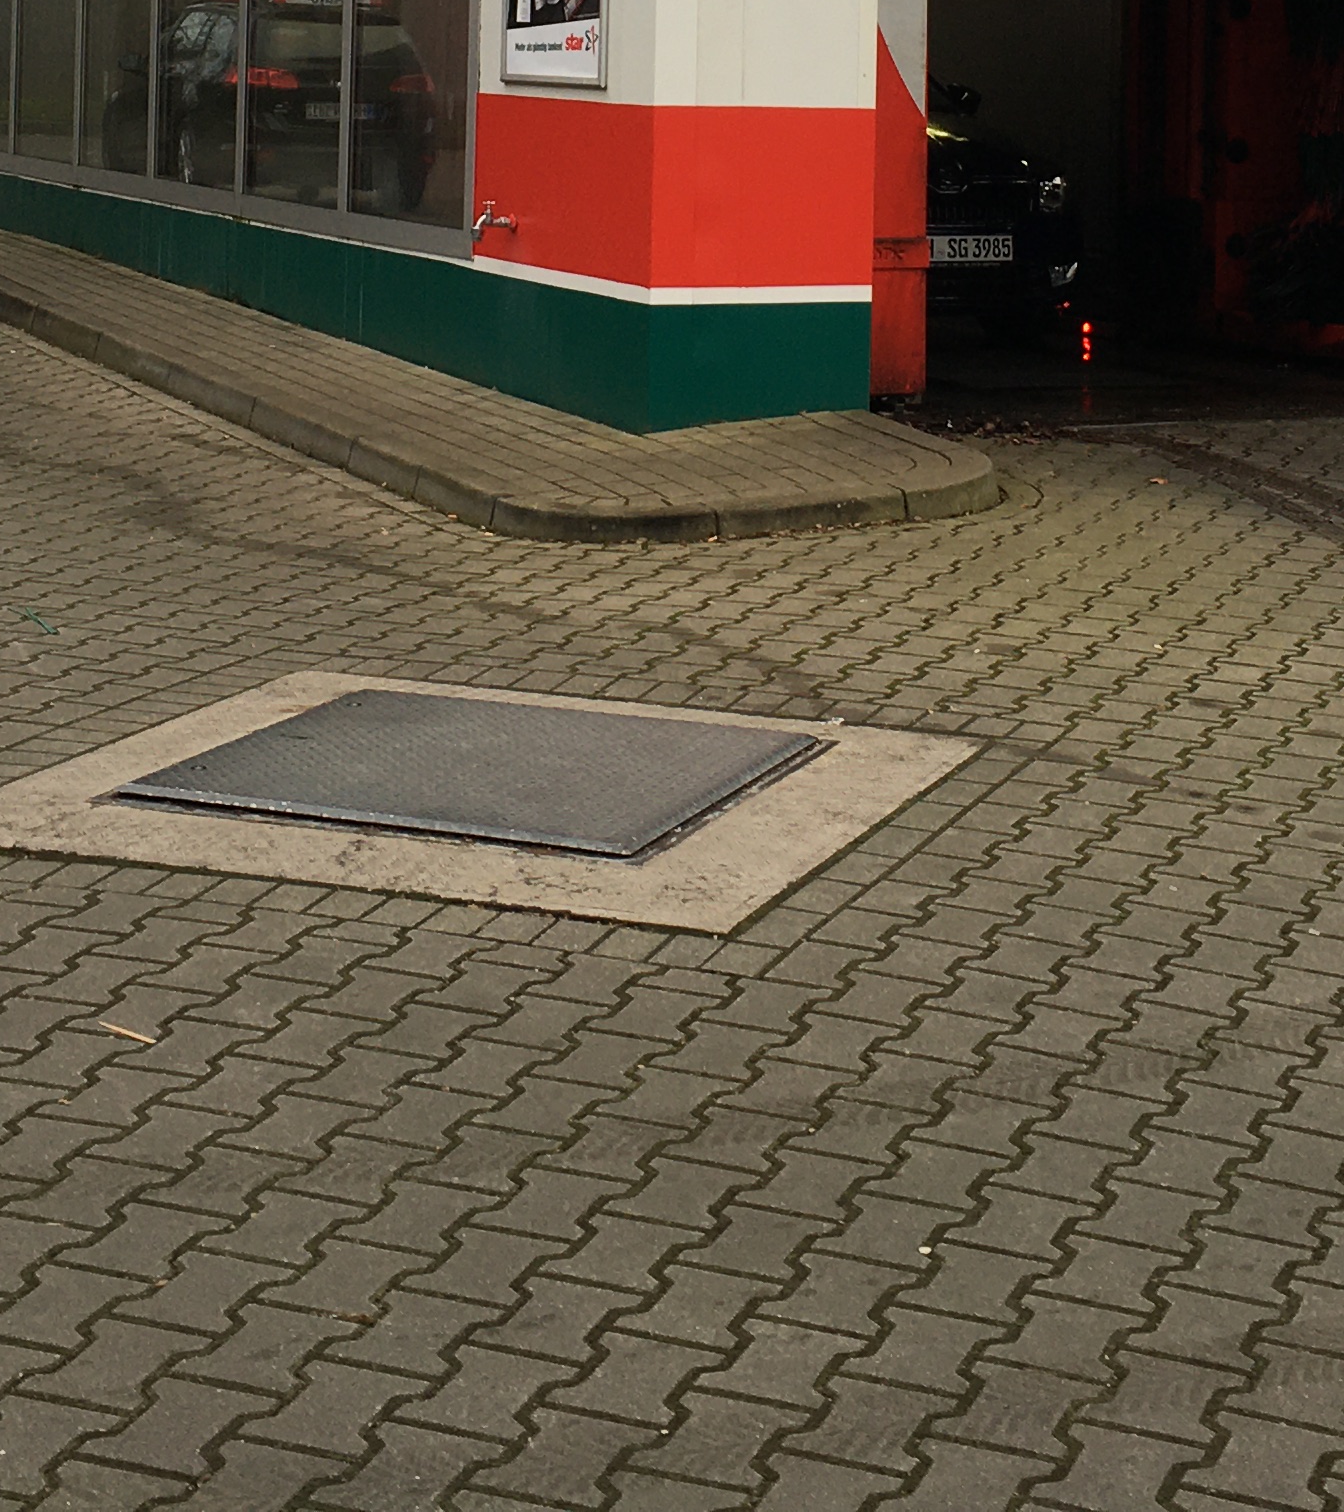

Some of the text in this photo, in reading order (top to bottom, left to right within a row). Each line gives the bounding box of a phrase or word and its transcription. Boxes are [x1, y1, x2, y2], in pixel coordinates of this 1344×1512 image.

[565, 33, 584, 51] star
[947, 238, 969, 258] SG
[972, 238, 1011, 258] 3985
